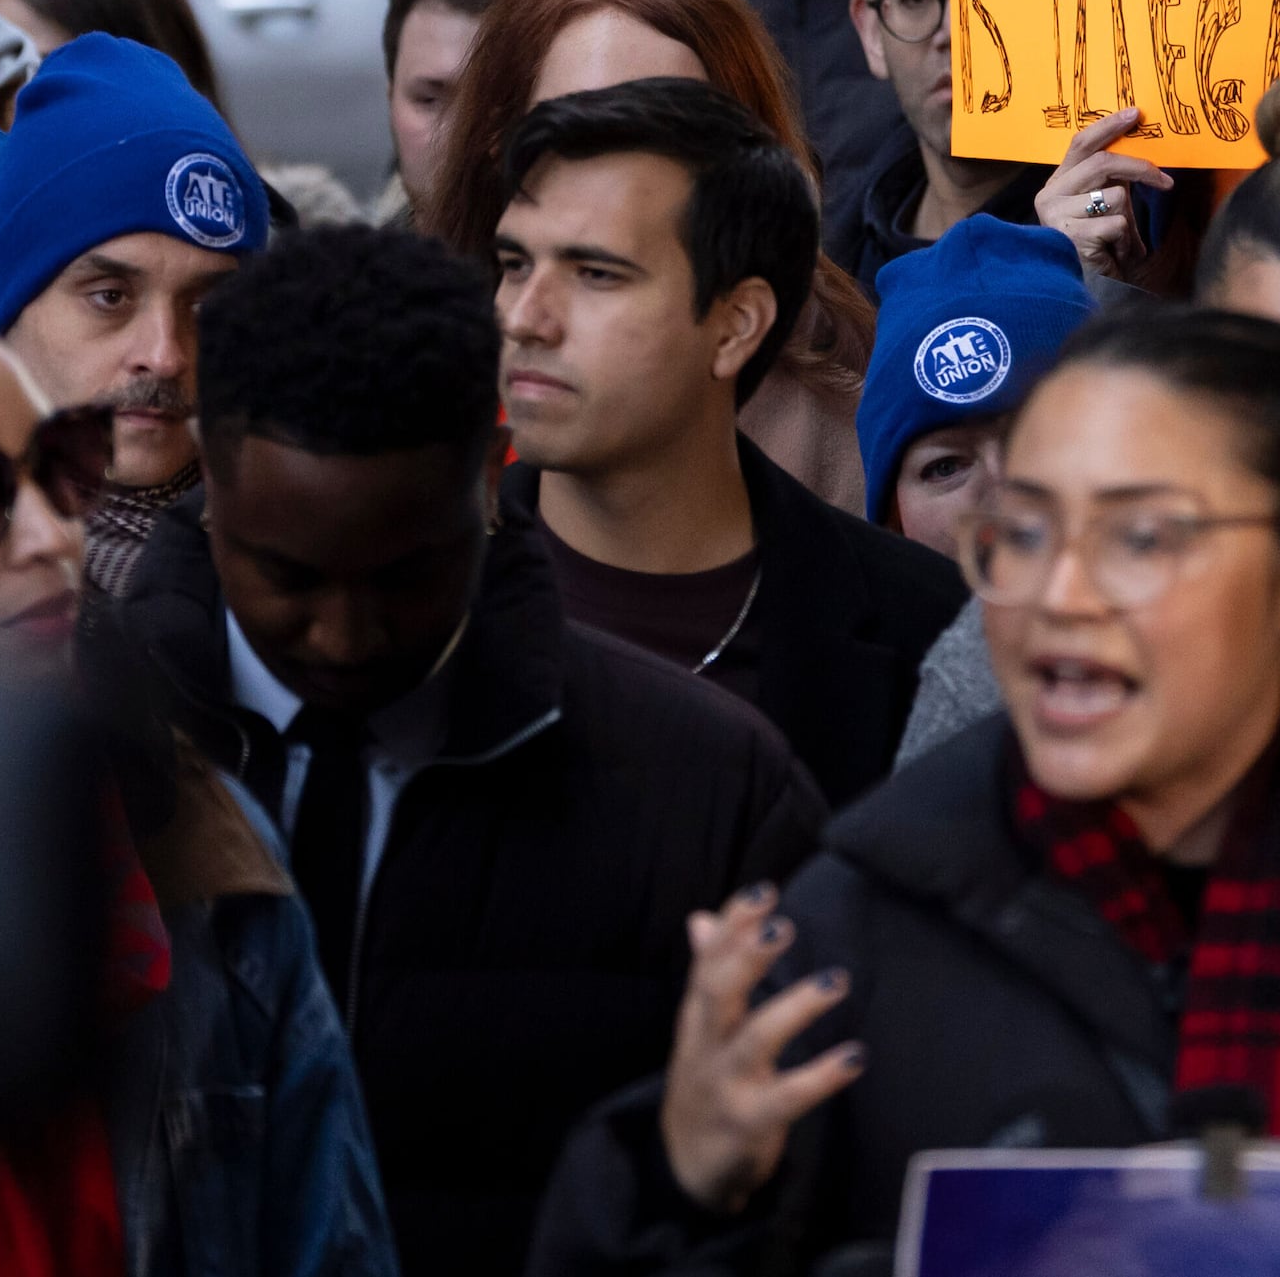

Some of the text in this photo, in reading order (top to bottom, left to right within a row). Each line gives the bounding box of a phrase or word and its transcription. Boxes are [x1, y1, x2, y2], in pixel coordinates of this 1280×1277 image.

[184, 175, 234, 211] ALE
[184, 200, 236, 231] UNION
[935, 332, 991, 377] ALE
[937, 353, 998, 388] UNION
